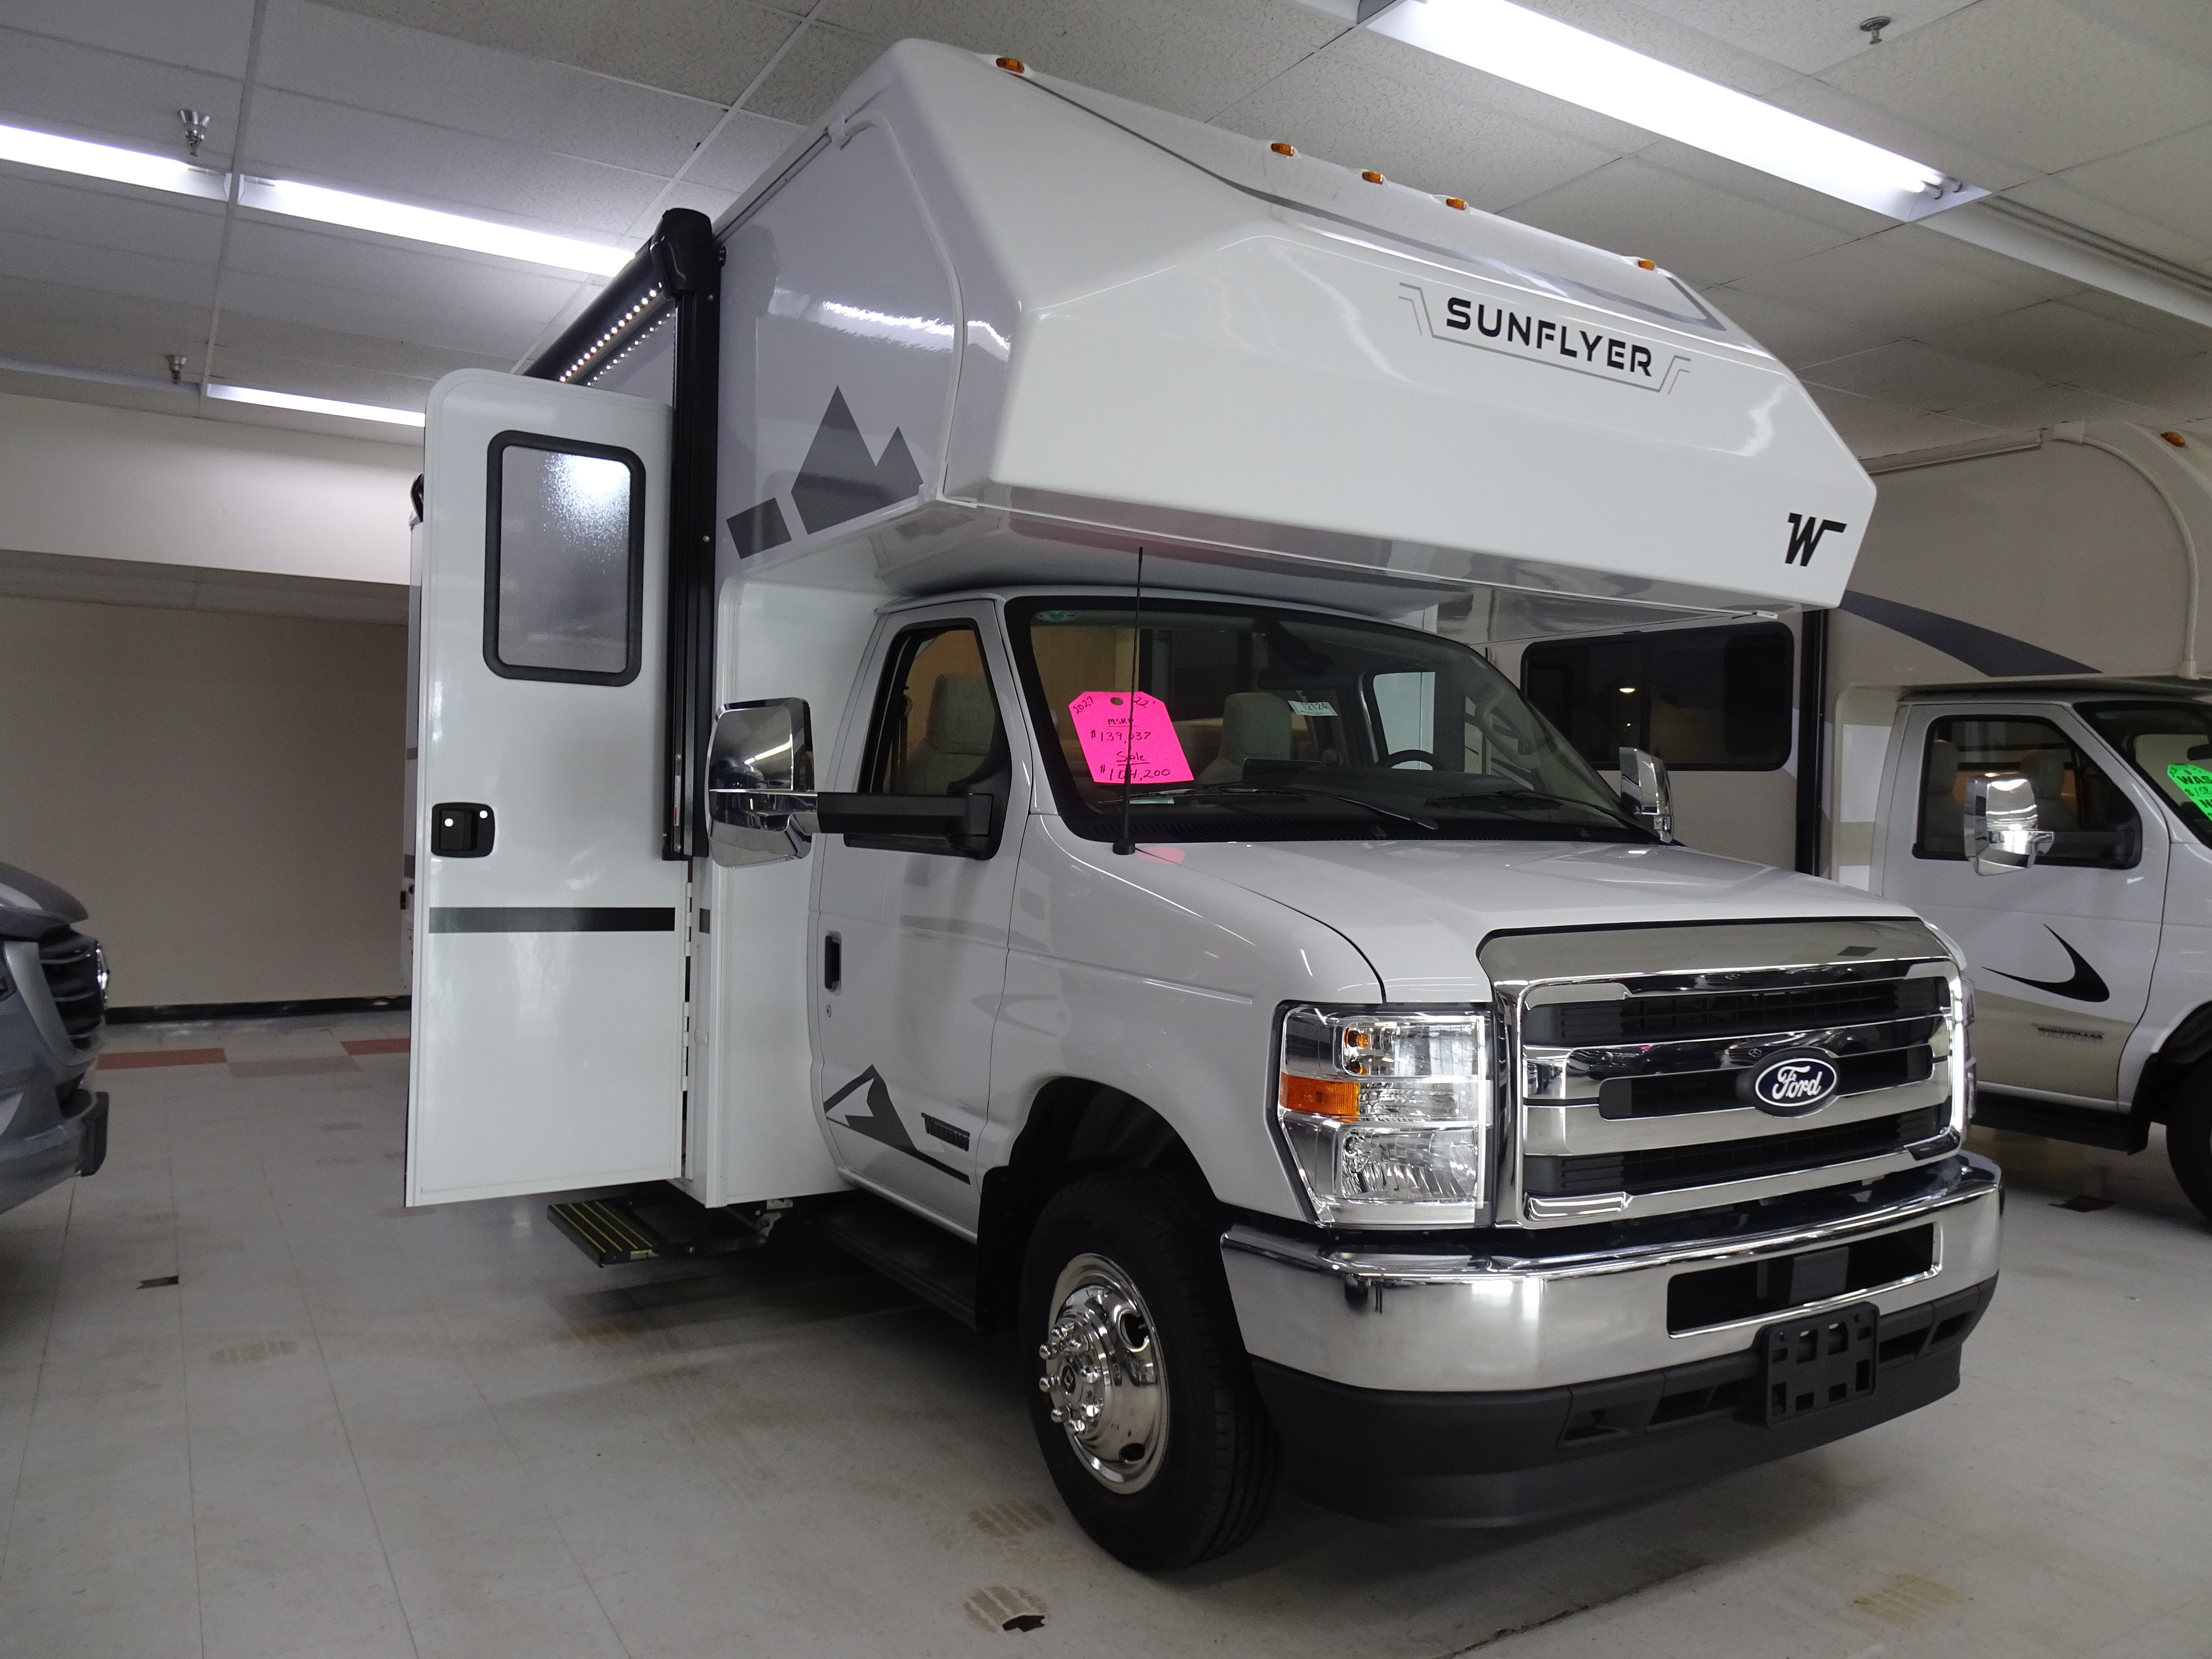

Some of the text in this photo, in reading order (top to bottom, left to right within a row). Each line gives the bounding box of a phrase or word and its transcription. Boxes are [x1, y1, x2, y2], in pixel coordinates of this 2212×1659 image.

[1446, 297, 1651, 376] SUNFLYER
[1073, 696, 1094, 714] 2027
[1116, 751, 1146, 763] Sale
[1771, 1065, 1823, 1100] Ford
